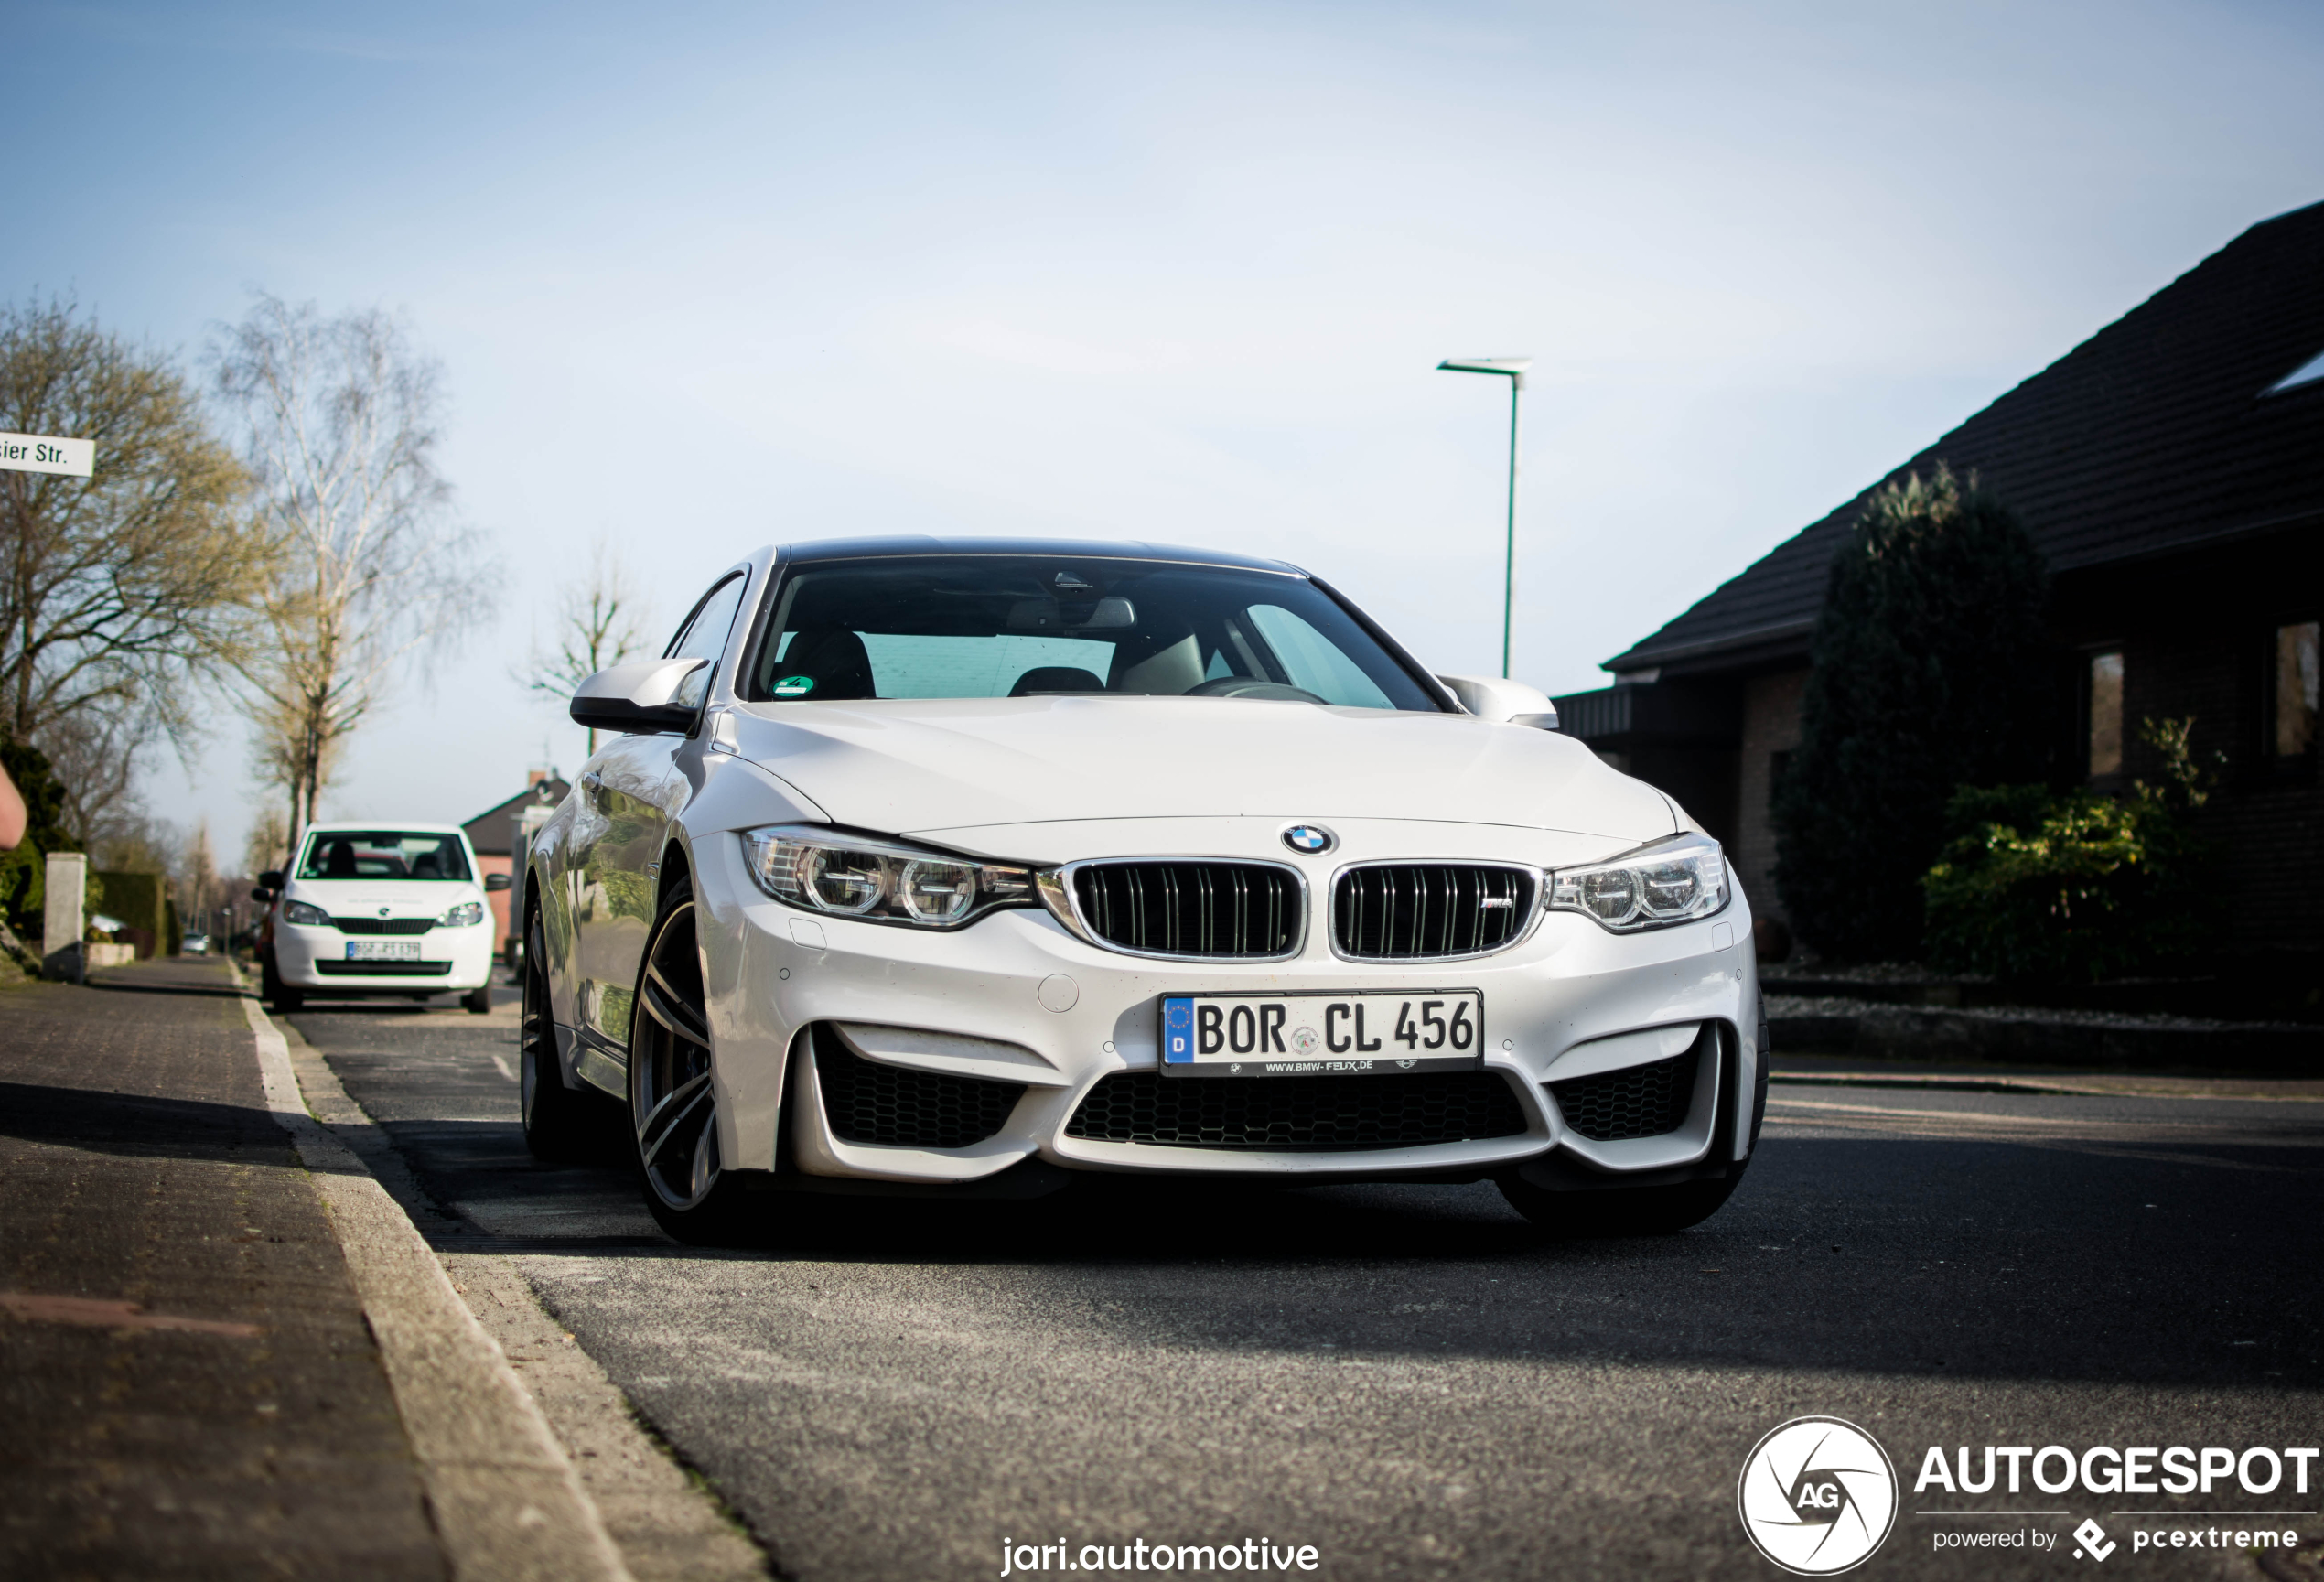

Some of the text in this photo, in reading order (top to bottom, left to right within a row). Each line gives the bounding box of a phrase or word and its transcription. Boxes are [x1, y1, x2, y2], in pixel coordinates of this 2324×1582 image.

[0, 440, 68, 464] ier Str.
[789, 678, 801, 686] 4
[1198, 1000, 1474, 1054] BOR CL 456
[1172, 1037, 1185, 1052] D
